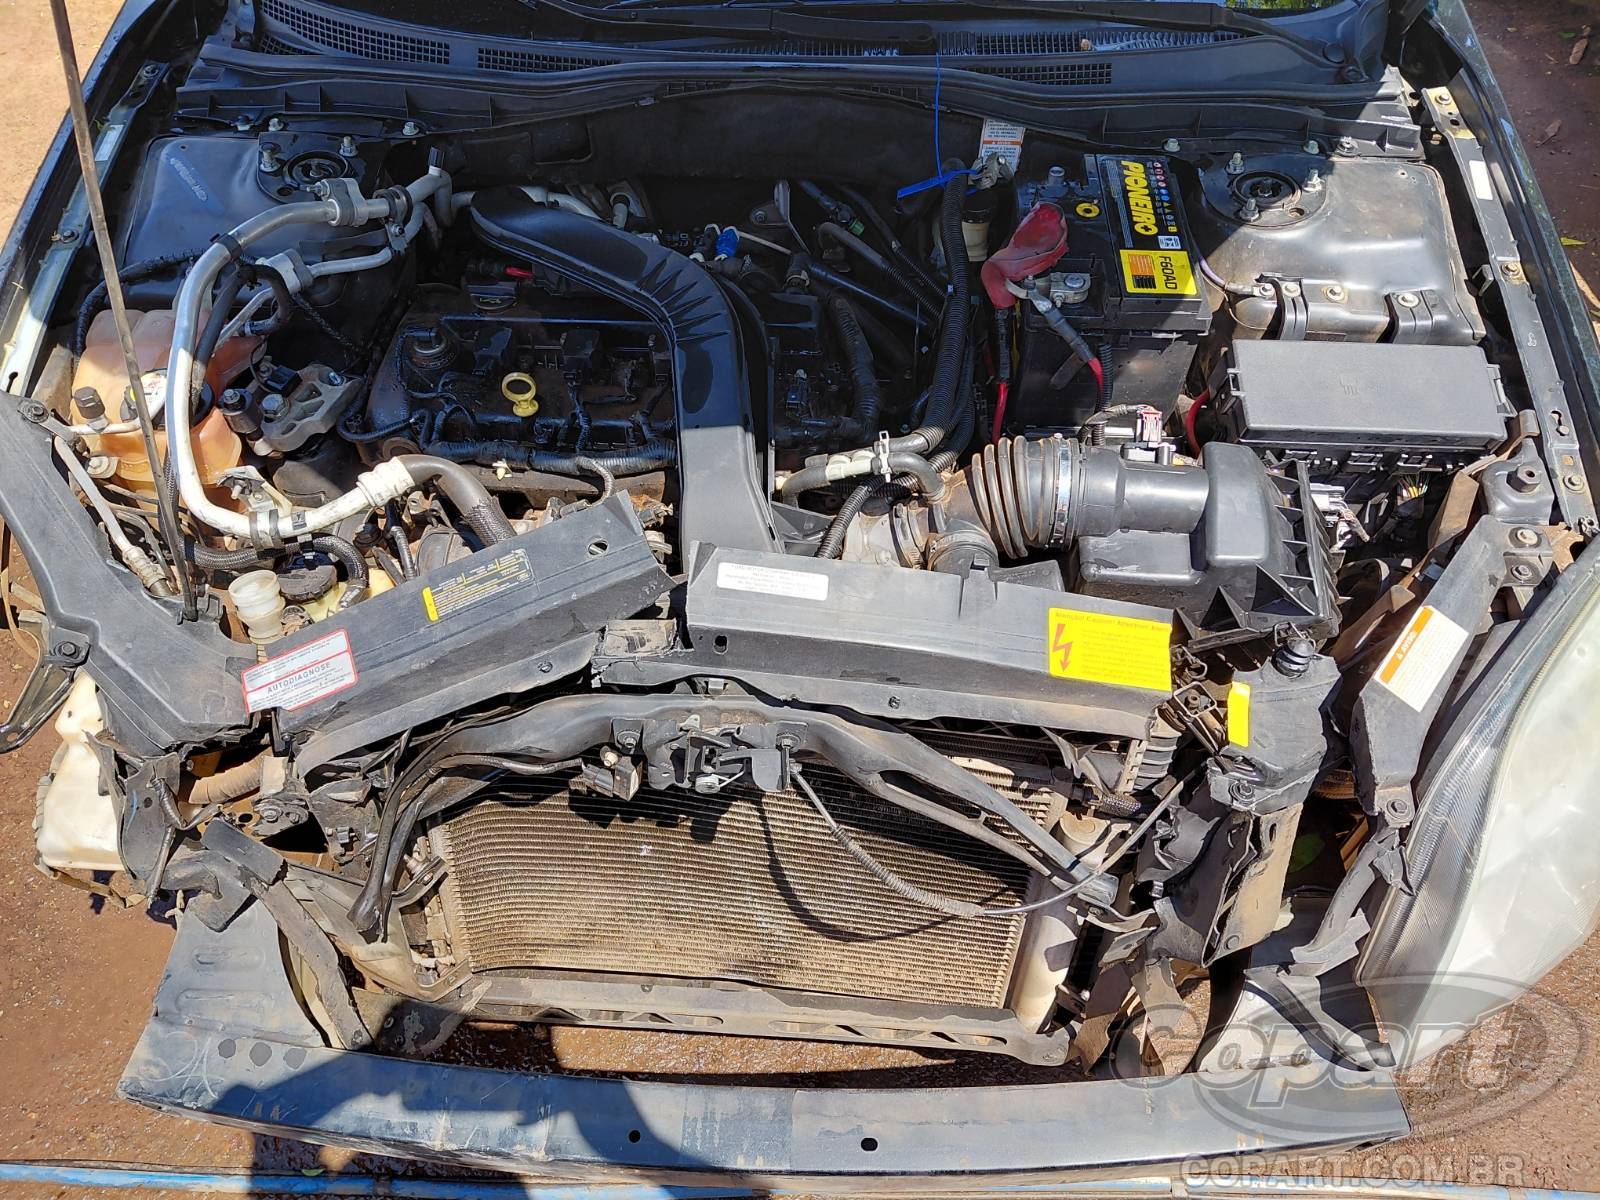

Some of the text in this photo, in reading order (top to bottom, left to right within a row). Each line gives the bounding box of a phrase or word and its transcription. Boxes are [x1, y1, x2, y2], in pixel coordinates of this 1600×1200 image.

[1121, 160, 1158, 235] PIONEIRO
[1159, 255, 1178, 290] F60AD
[267, 661, 331, 694] AUTODIAGNOSE
